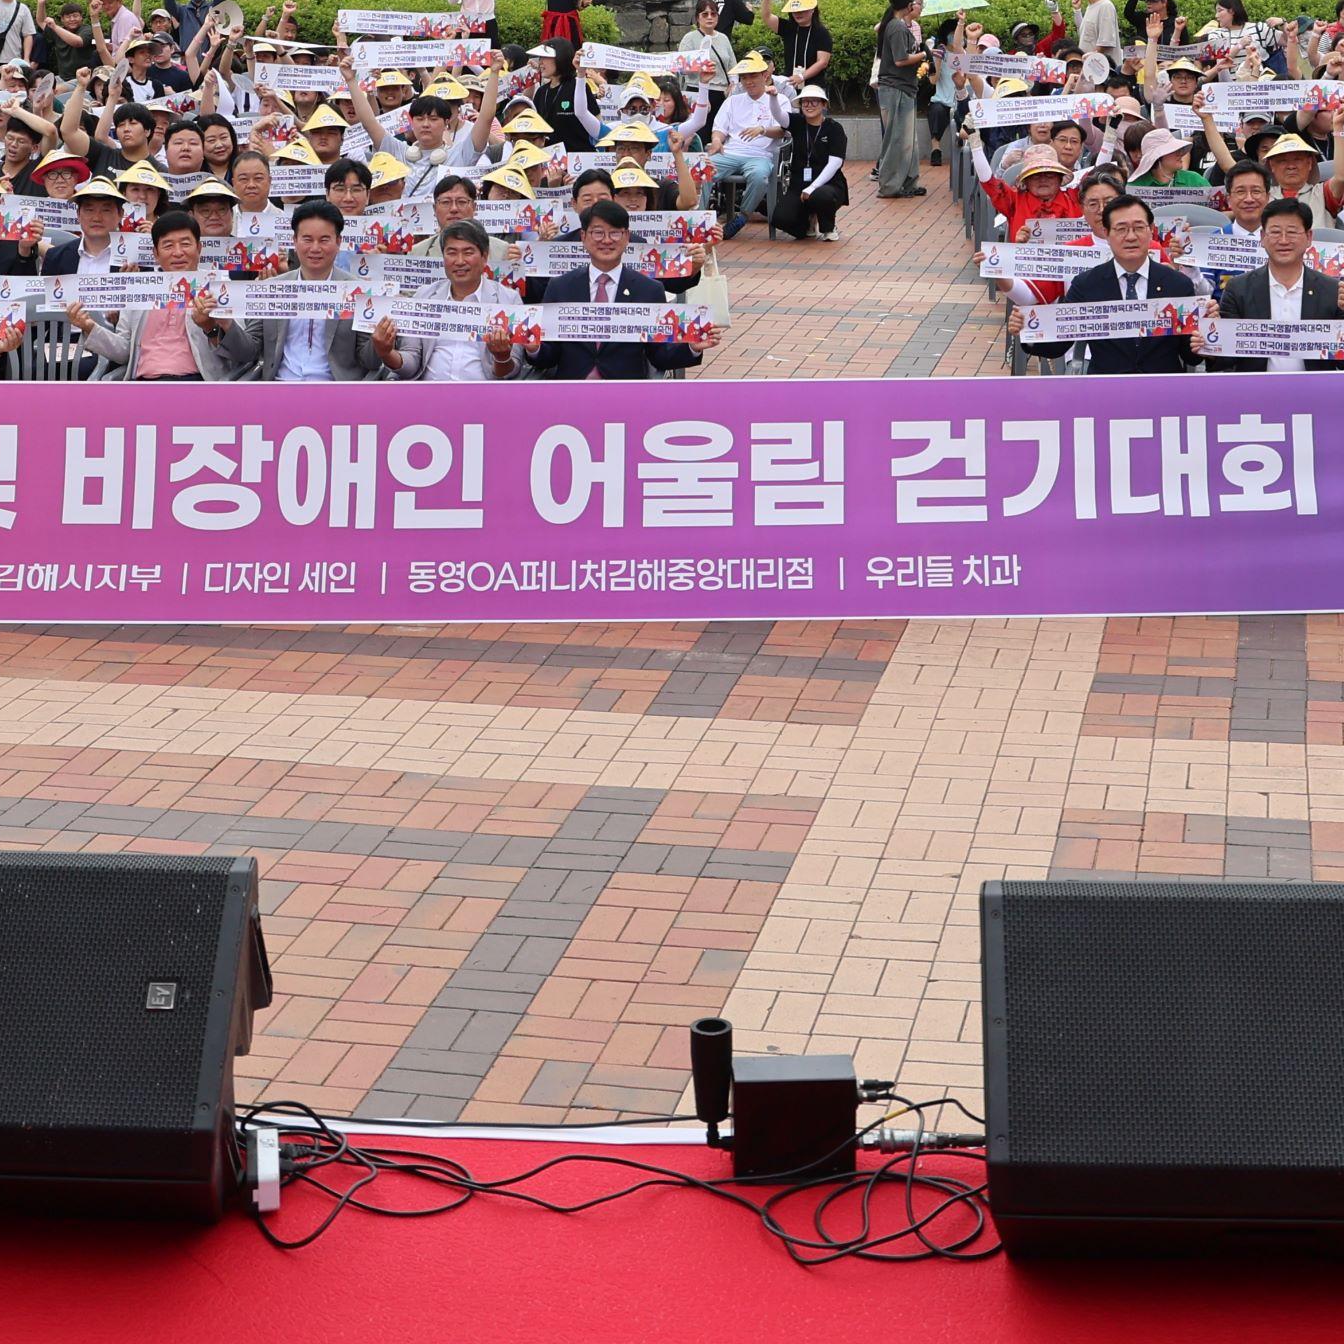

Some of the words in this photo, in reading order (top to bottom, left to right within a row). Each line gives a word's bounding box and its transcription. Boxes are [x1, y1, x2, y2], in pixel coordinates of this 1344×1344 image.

[1246, 83, 1299, 91] 전국생활체육대축전
[1208, 237, 1229, 245] 2026
[549, 245, 570, 253] 2026
[1015, 247, 1035, 256] 2026
[1037, 247, 1101, 259] 전국생활체육대축전
[383, 258, 403, 266] 2026
[78, 277, 99, 285] 2026
[100, 276, 164, 286] 전국생활체육대축전
[246, 284, 268, 293] 2026
[269, 284, 337, 294] 전국생활체육대축전
[99, 293, 185, 304] 전국어울림생활체육대축전
[392, 301, 413, 310] 2026
[415, 302, 481, 315] 전국생활체육대축전
[558, 307, 580, 315] 2026
[582, 307, 650, 316] 전국생활체육대축전
[1056, 307, 1078, 316] 2026
[1079, 303, 1149, 315] 전국생활체육대축전
[581, 325, 673, 335] 전국어울림생활체육대축전
[1079, 319, 1173, 332] 전국어울림생활체육대축전
[1236, 322, 1259, 332] 2026
[1260, 323, 1331, 333] 전국생활체육대축전
[61, 423, 485, 530] 비장애인
[529, 419, 845, 529] 어울림
[890, 413, 1319, 524] 걷기대회
[204, 560, 290, 594] 디자인
[298, 561, 357, 594] 세인
[408, 557, 814, 594] 동영OA퍼니처김해중앙대리점
[865, 554, 955, 589] 우리들
[962, 553, 1022, 588] 치과
